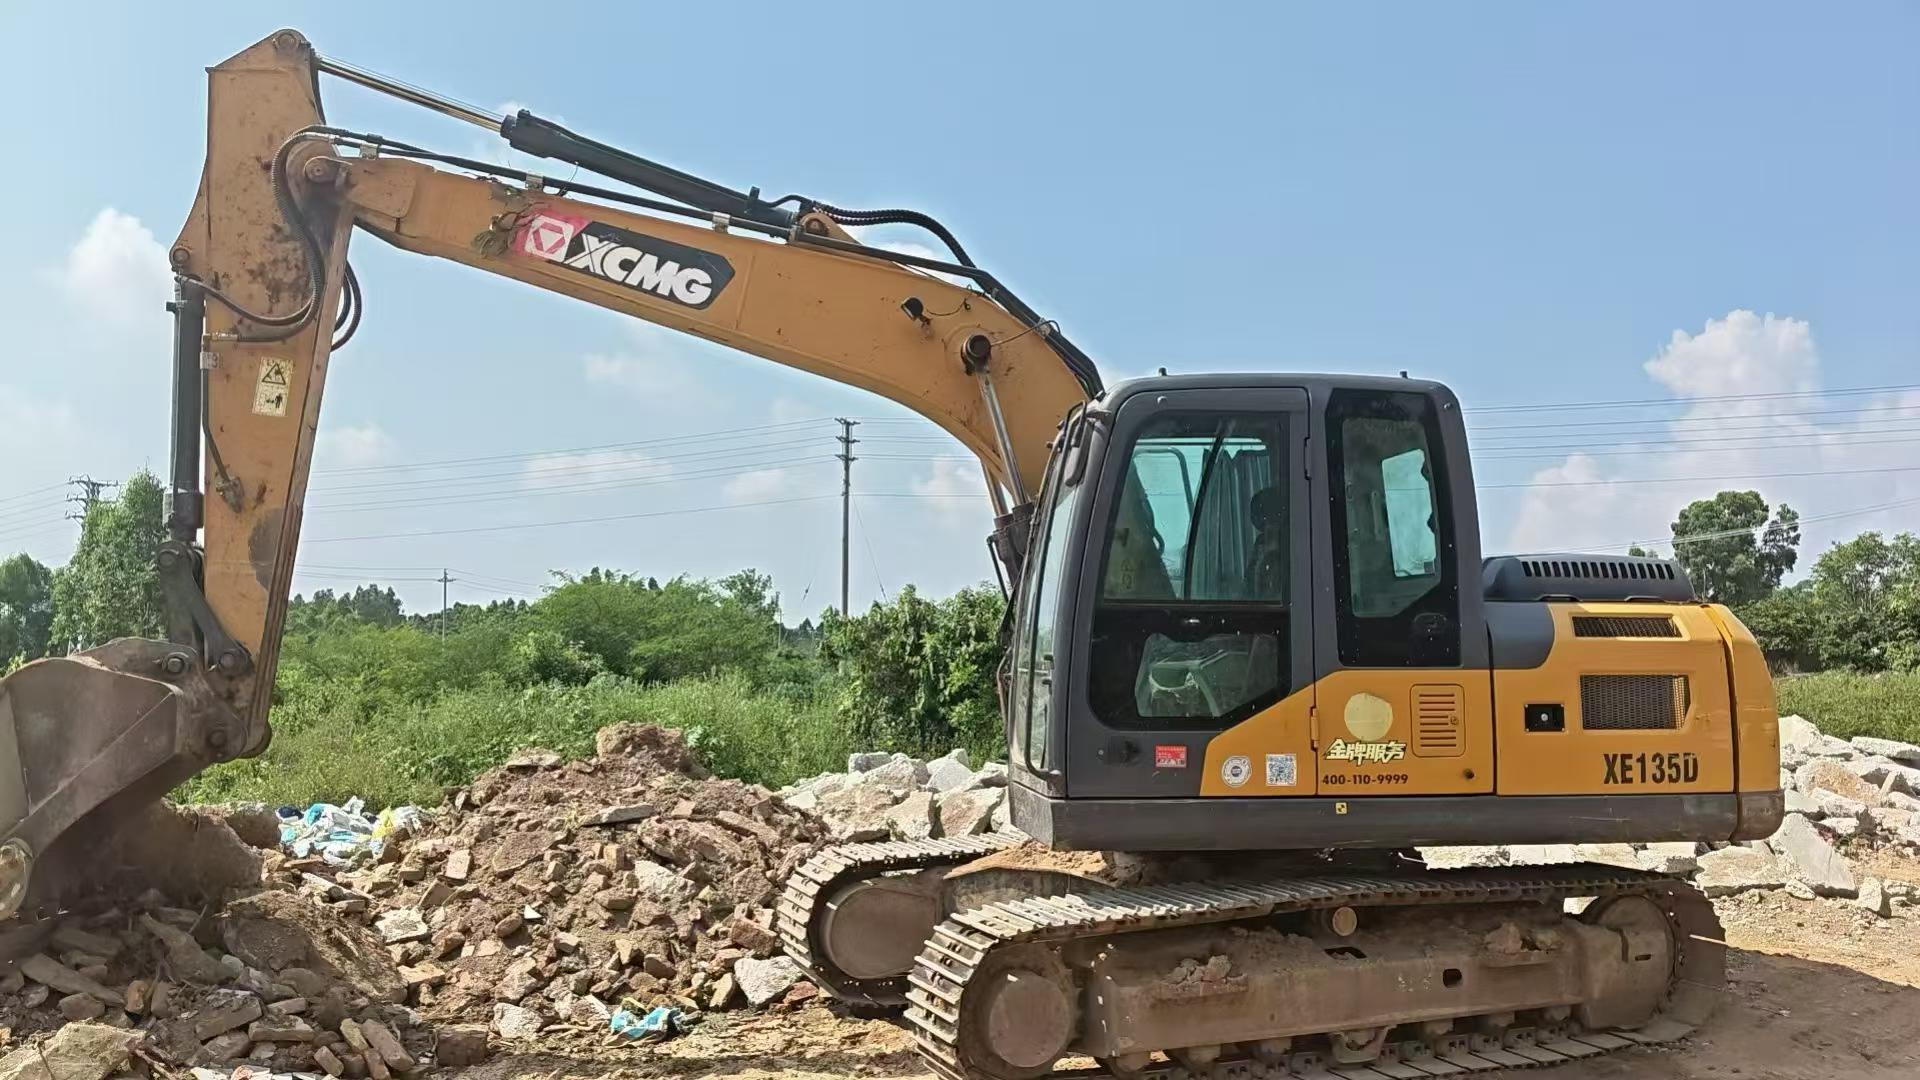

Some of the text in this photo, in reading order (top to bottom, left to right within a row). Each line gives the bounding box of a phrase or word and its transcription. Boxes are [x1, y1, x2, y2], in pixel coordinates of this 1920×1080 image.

[564, 233, 712, 304] XCMG
[1325, 738, 1407, 766] 金牌服务
[1322, 774, 1409, 785] 400-110-9999
[1603, 752, 1699, 785] XE135D
